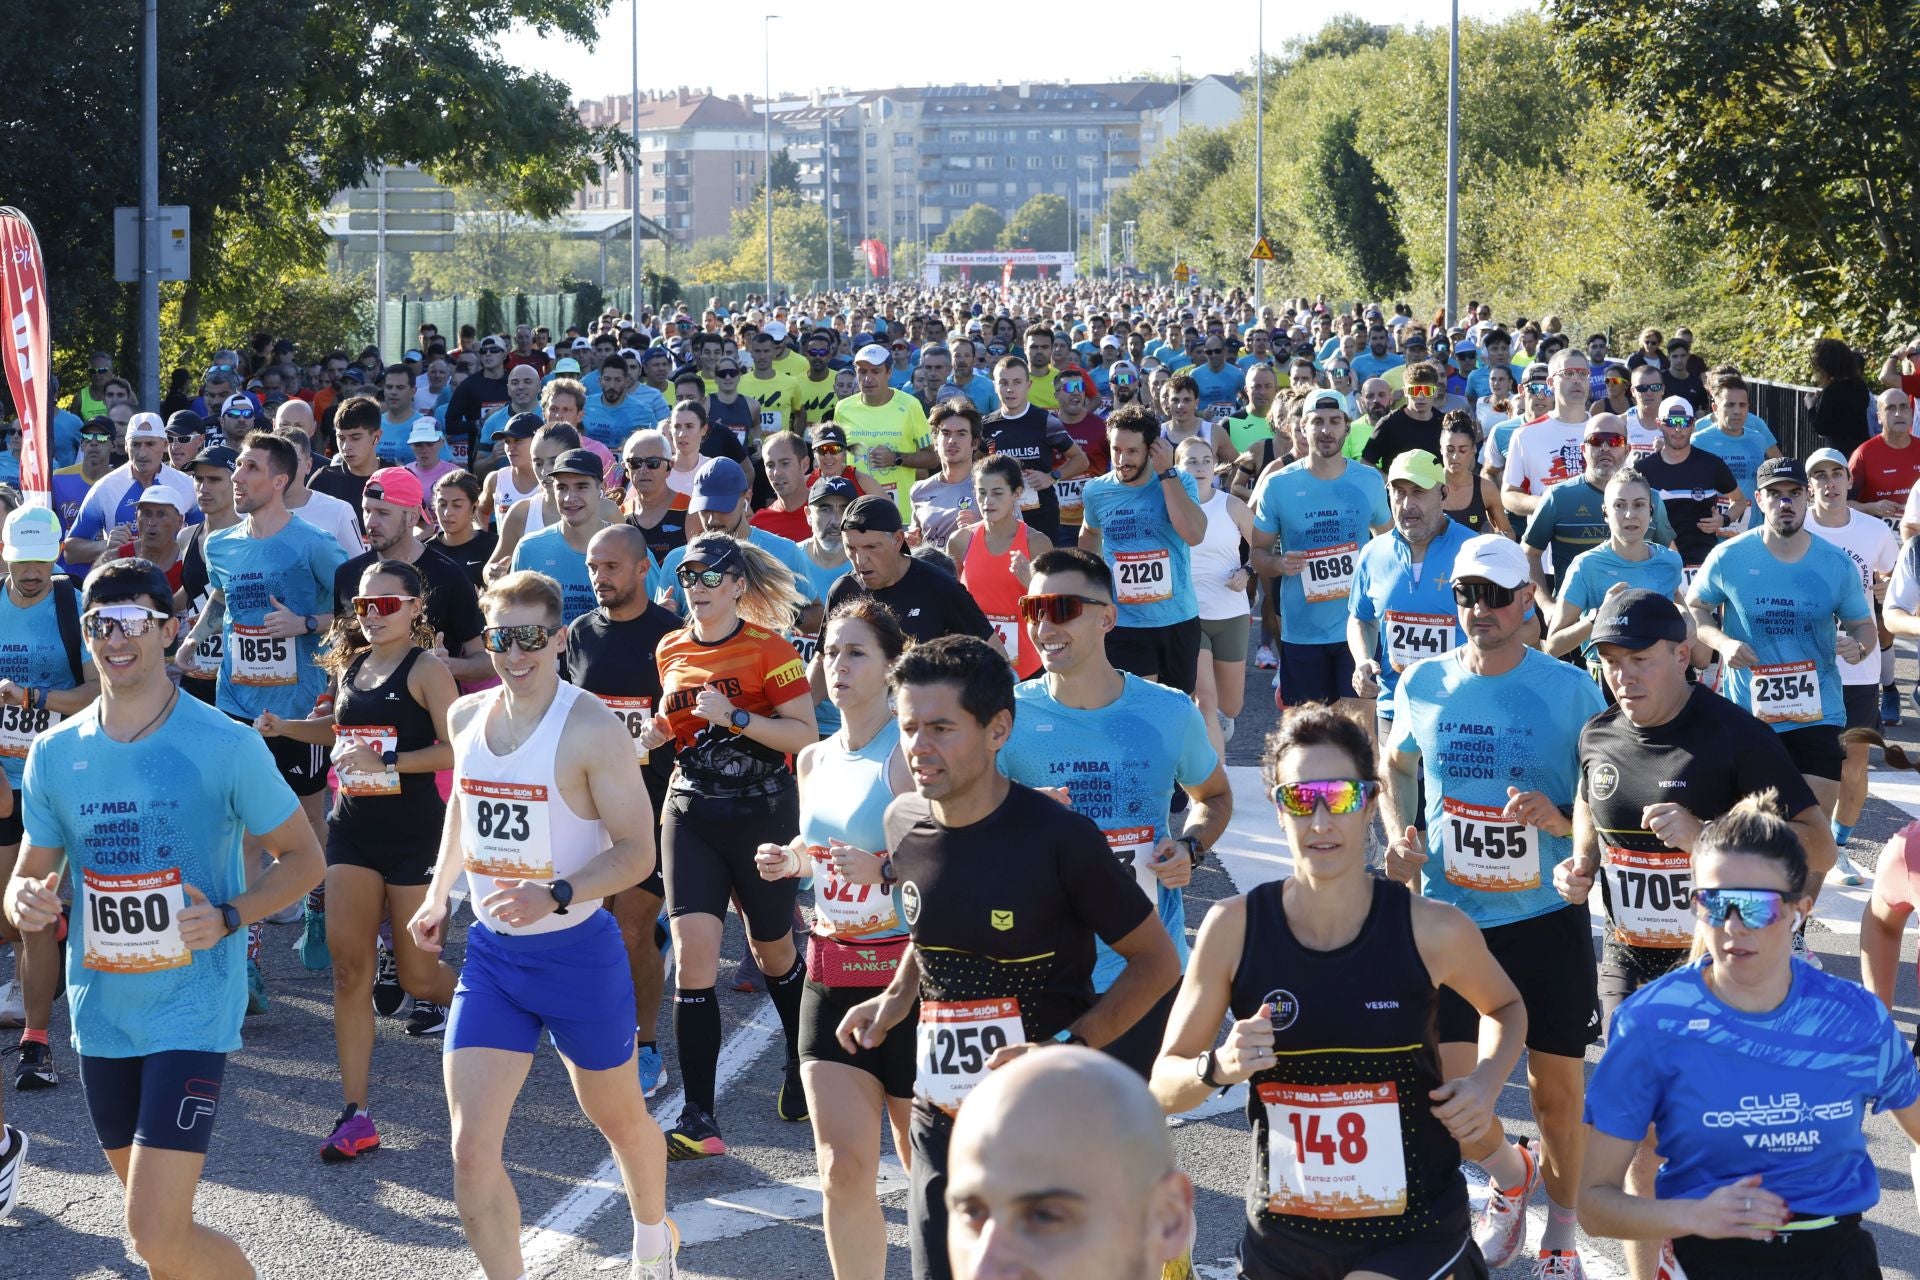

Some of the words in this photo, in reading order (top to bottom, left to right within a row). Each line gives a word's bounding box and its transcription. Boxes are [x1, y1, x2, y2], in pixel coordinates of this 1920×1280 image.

[1057, 480, 1087, 497] 174
[1318, 510, 1339, 518] MBA
[1313, 519, 1340, 528] media
[1119, 561, 1164, 584] 2120
[1308, 554, 1354, 582] 1698
[240, 572, 263, 581] MBA
[236, 583, 265, 591] media
[1771, 598, 1794, 606] MBA
[1755, 616, 1795, 625] maratón
[1765, 609, 1795, 618] media
[1393, 624, 1447, 653] 2441
[238, 637, 287, 662] 1855
[1755, 674, 1815, 702] 2354
[0, 704, 51, 734] 388
[1438, 722, 1458, 732] 14ª
[1458, 723, 1495, 736] MBA
[1450, 739, 1494, 753] media
[1436, 751, 1494, 765] maratón
[1049, 762, 1071, 774] 14ª
[1072, 761, 1111, 772] MBA
[1448, 764, 1494, 780] GIJÓN
[1066, 777, 1112, 791] media
[1658, 780, 1687, 788] VESKIN
[483, 786, 500, 795] MBA
[513, 788, 533, 797] GIJÓN
[80, 801, 100, 816] 14ª
[101, 800, 138, 814] MBA
[1466, 808, 1485, 817] MBA
[93, 818, 139, 834] media
[477, 800, 530, 842] 823
[84, 832, 140, 848] maratón
[1117, 831, 1140, 843] GIJÓN
[1451, 819, 1527, 859] 1455
[95, 848, 140, 866] GIJÓN
[1629, 856, 1648, 865] MBA
[1664, 856, 1688, 866] GIJÓN
[98, 879, 119, 888] MBA
[137, 876, 162, 887] GIJÓN
[1616, 869, 1692, 911] 1705
[89, 893, 170, 934] 1660
[973, 1005, 999, 1017] GIJÓN
[1364, 1000, 1400, 1010] VESKIN
[928, 1024, 1008, 1074] 1259
[1295, 1092, 1320, 1102] MBA
[1342, 1089, 1374, 1101] GIJÓN
[1740, 1092, 1801, 1109] CLUB
[1288, 1111, 1369, 1166] 148
[1759, 1130, 1821, 1149] AMBAR
[1794, 1145, 1815, 1153] ZERO
